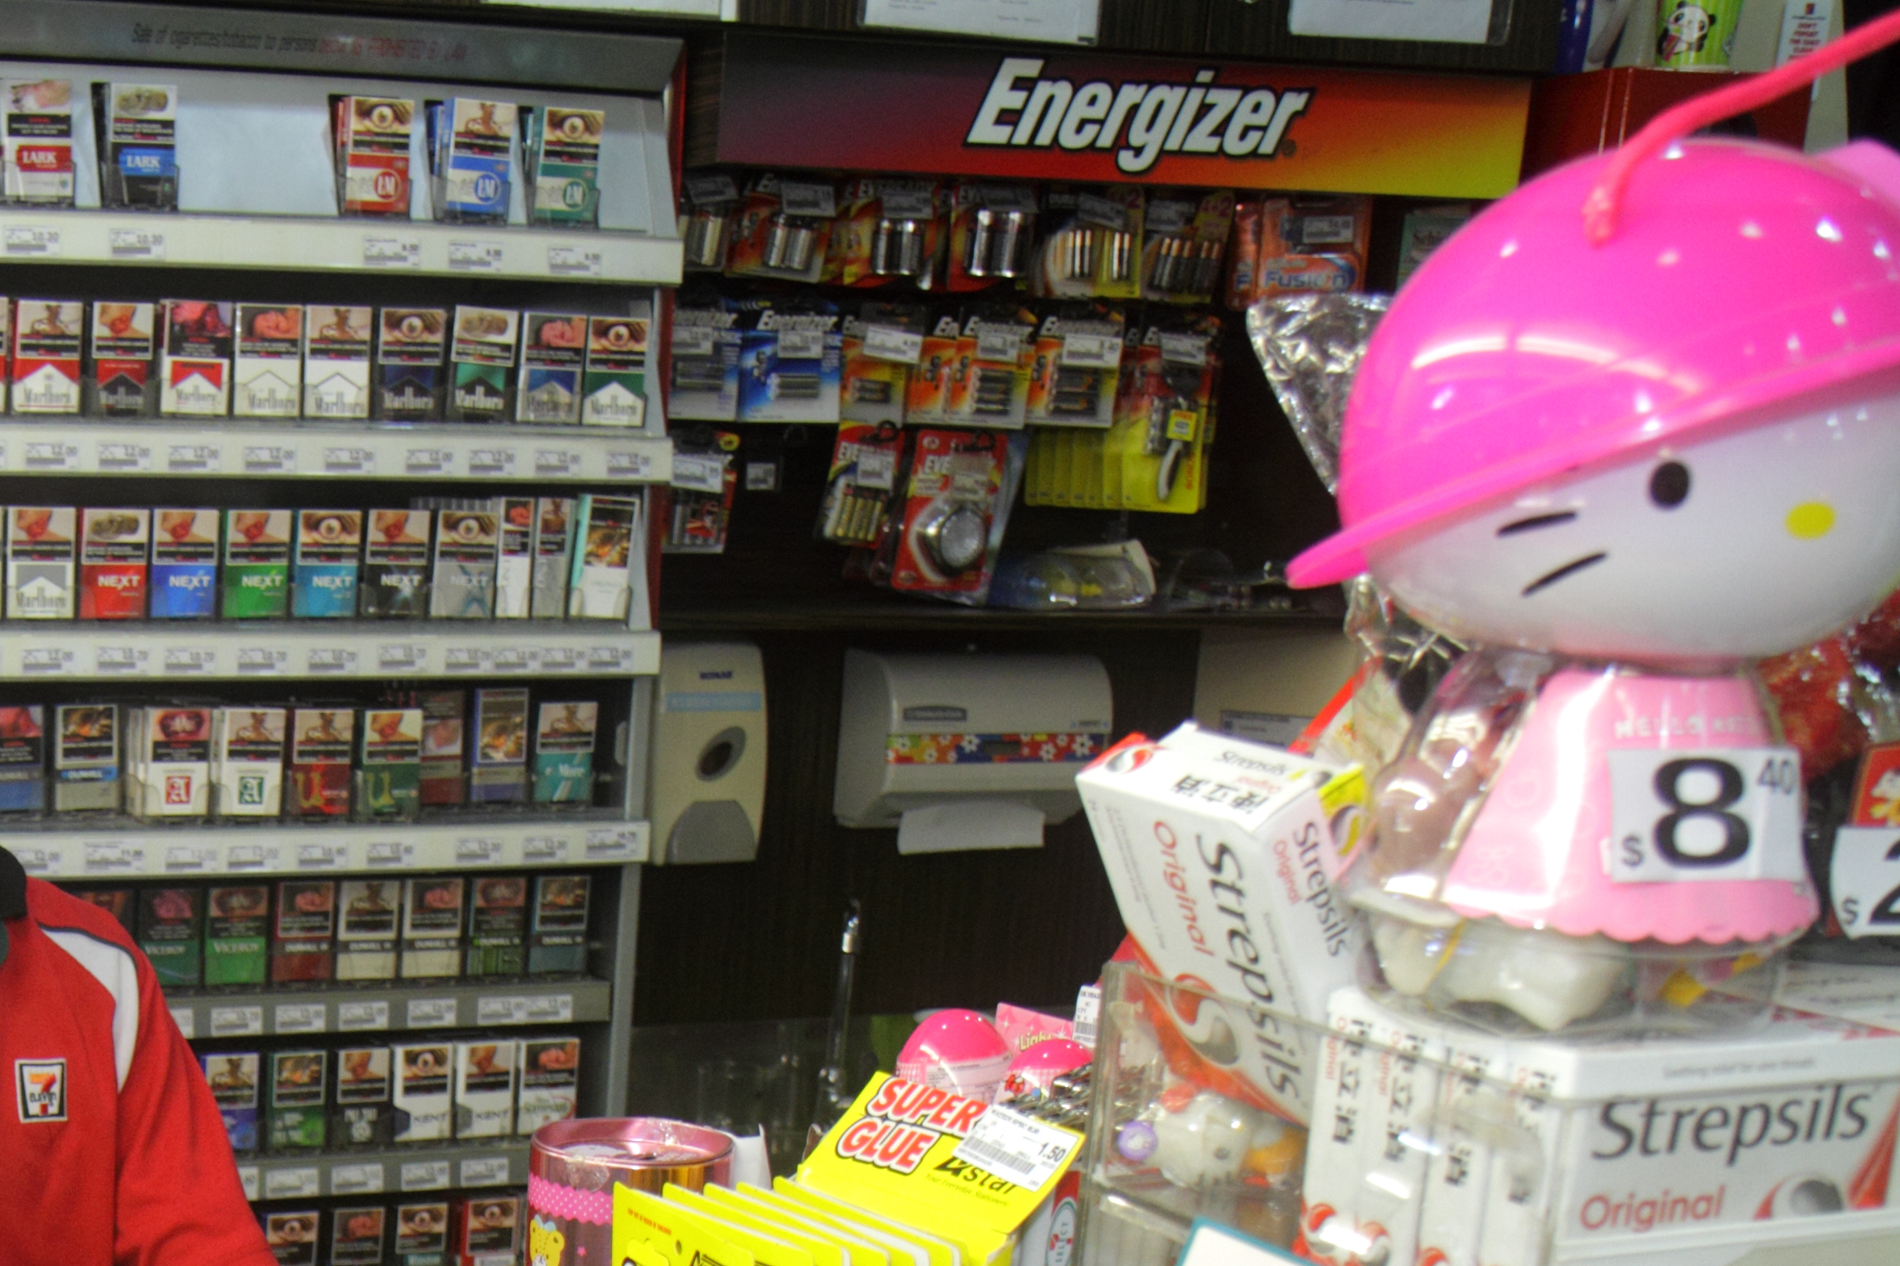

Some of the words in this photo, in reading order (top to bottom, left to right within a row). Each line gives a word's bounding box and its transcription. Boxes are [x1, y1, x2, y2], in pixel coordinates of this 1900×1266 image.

[967, 58, 1309, 172] Energizer
[23, 151, 56, 164] LARK
[127, 156, 159, 168] LARK
[1264, 269, 1348, 289] Fusion
[97, 575, 140, 588] NEXT
[169, 575, 210, 588] NEXT
[241, 575, 283, 588] NEXT
[312, 576, 353, 587] NEXT
[381, 575, 422, 587] NEXT
[1153, 821, 1214, 957] Original
[1273, 839, 1299, 906] Original
[1294, 821, 1353, 958] Strepsils
[1198, 834, 1300, 1100] Strepsils
[872, 1078, 988, 1136] SUPER
[1592, 1085, 1871, 1166] Strepsils
[840, 1118, 938, 1173] GLUE
[1038, 1143, 1067, 1163] 1.50
[1579, 1185, 1725, 1231] Original
